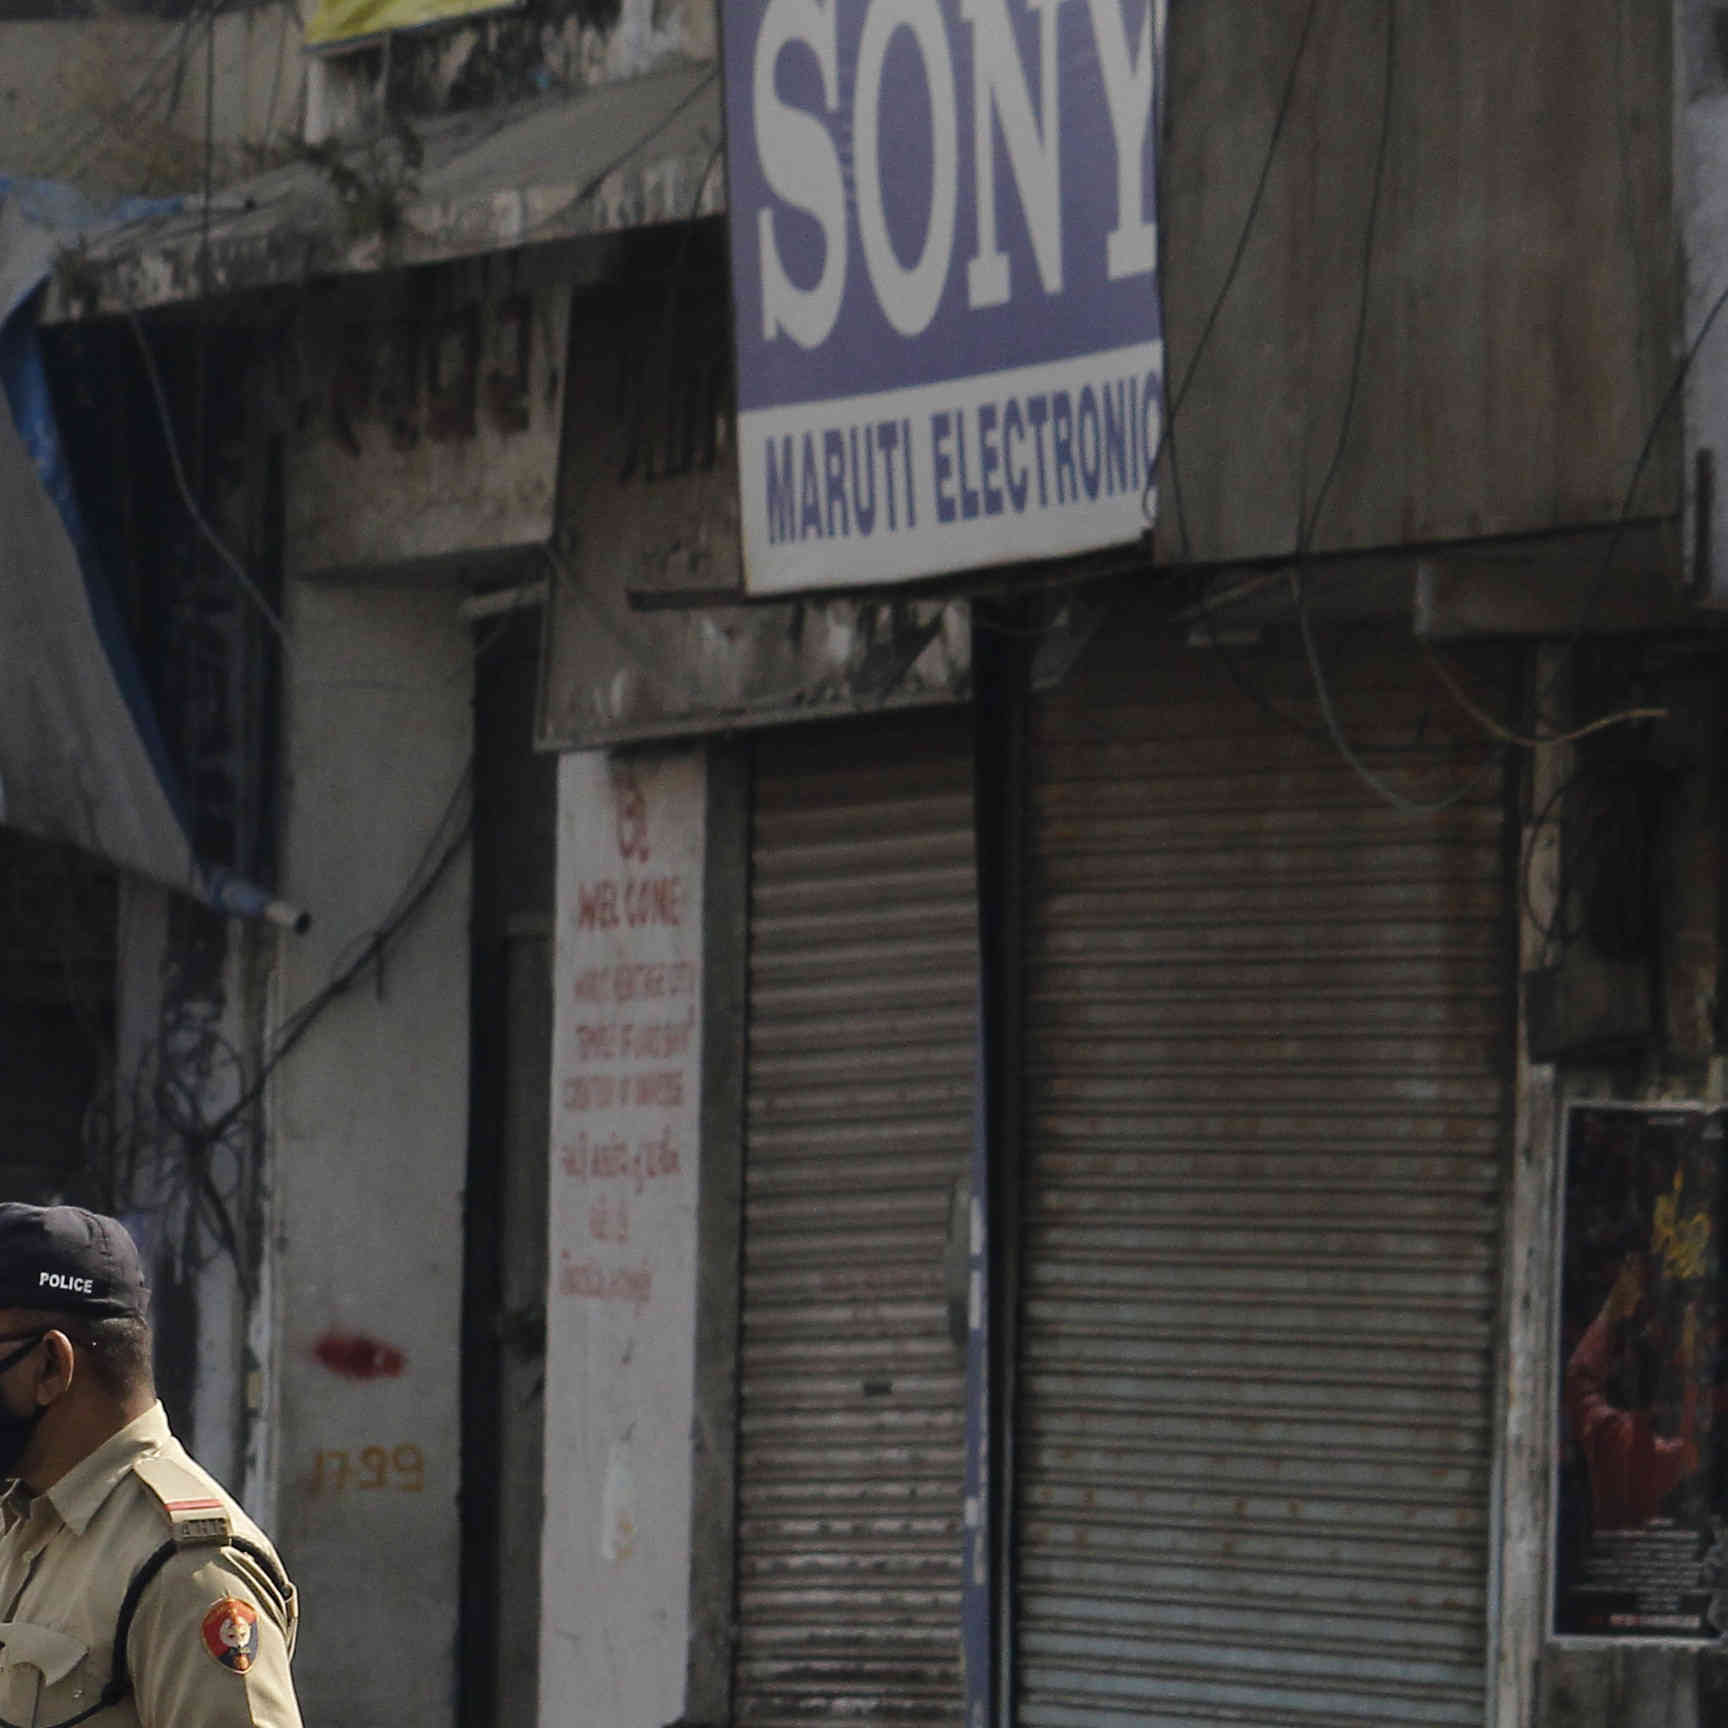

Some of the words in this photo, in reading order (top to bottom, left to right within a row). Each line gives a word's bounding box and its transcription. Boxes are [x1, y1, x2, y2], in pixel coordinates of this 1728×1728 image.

[753, 0, 1158, 350] SONY
[765, 416, 917, 546] MARUTI
[39, 1271, 94, 1294] POLICE
